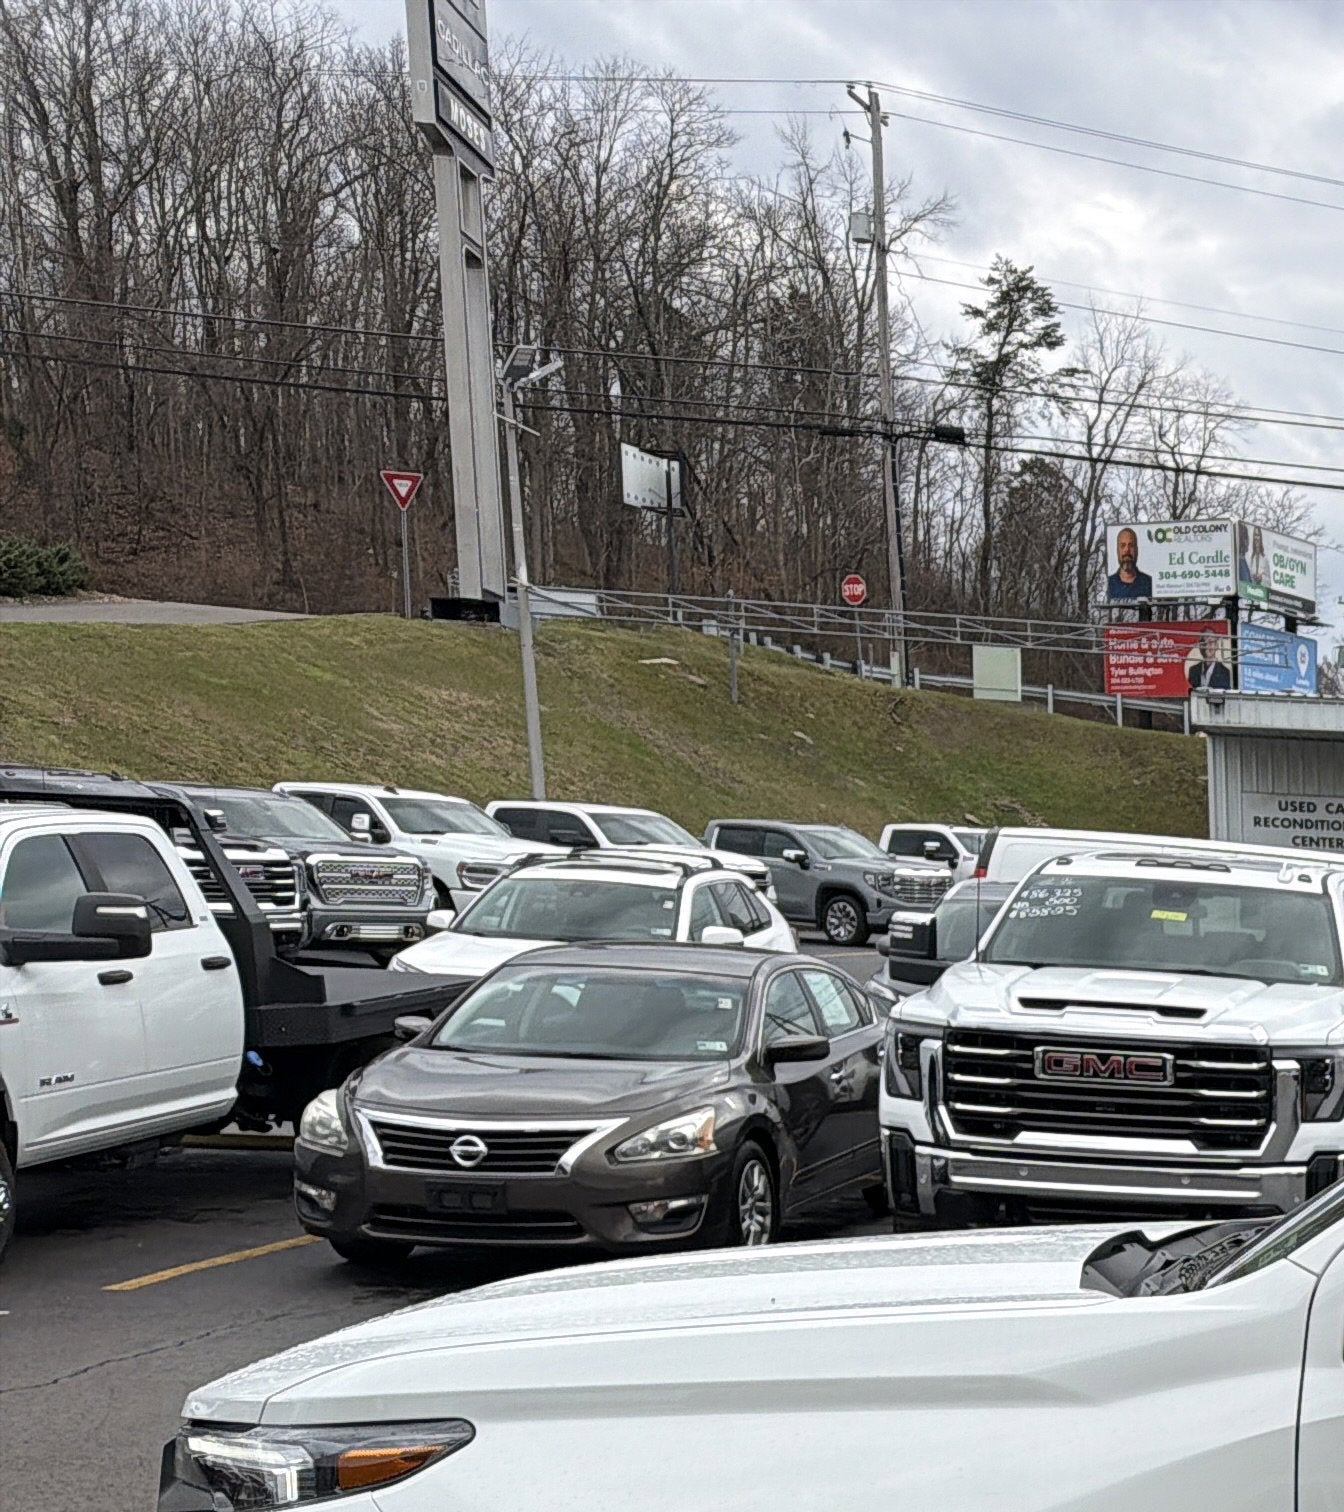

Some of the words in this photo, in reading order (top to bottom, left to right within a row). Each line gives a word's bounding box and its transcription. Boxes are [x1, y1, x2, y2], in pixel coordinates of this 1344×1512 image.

[437, 19, 490, 86] CADILLAC
[450, 98, 486, 151] MOSES
[1173, 526, 1191, 534] OLD
[1192, 524, 1228, 533] COLONY
[1168, 552, 1185, 565] Ed
[1188, 550, 1231, 565] Cordle
[1272, 552, 1307, 576] OB/GYN
[1158, 569, 1231, 580] 304-690-5448
[1272, 569, 1297, 589] CARE
[844, 583, 864, 596] STOP
[1278, 800, 1317, 814] USED
[1292, 836, 1344, 849] CENTER
[1045, 1052, 1163, 1081] GMC
